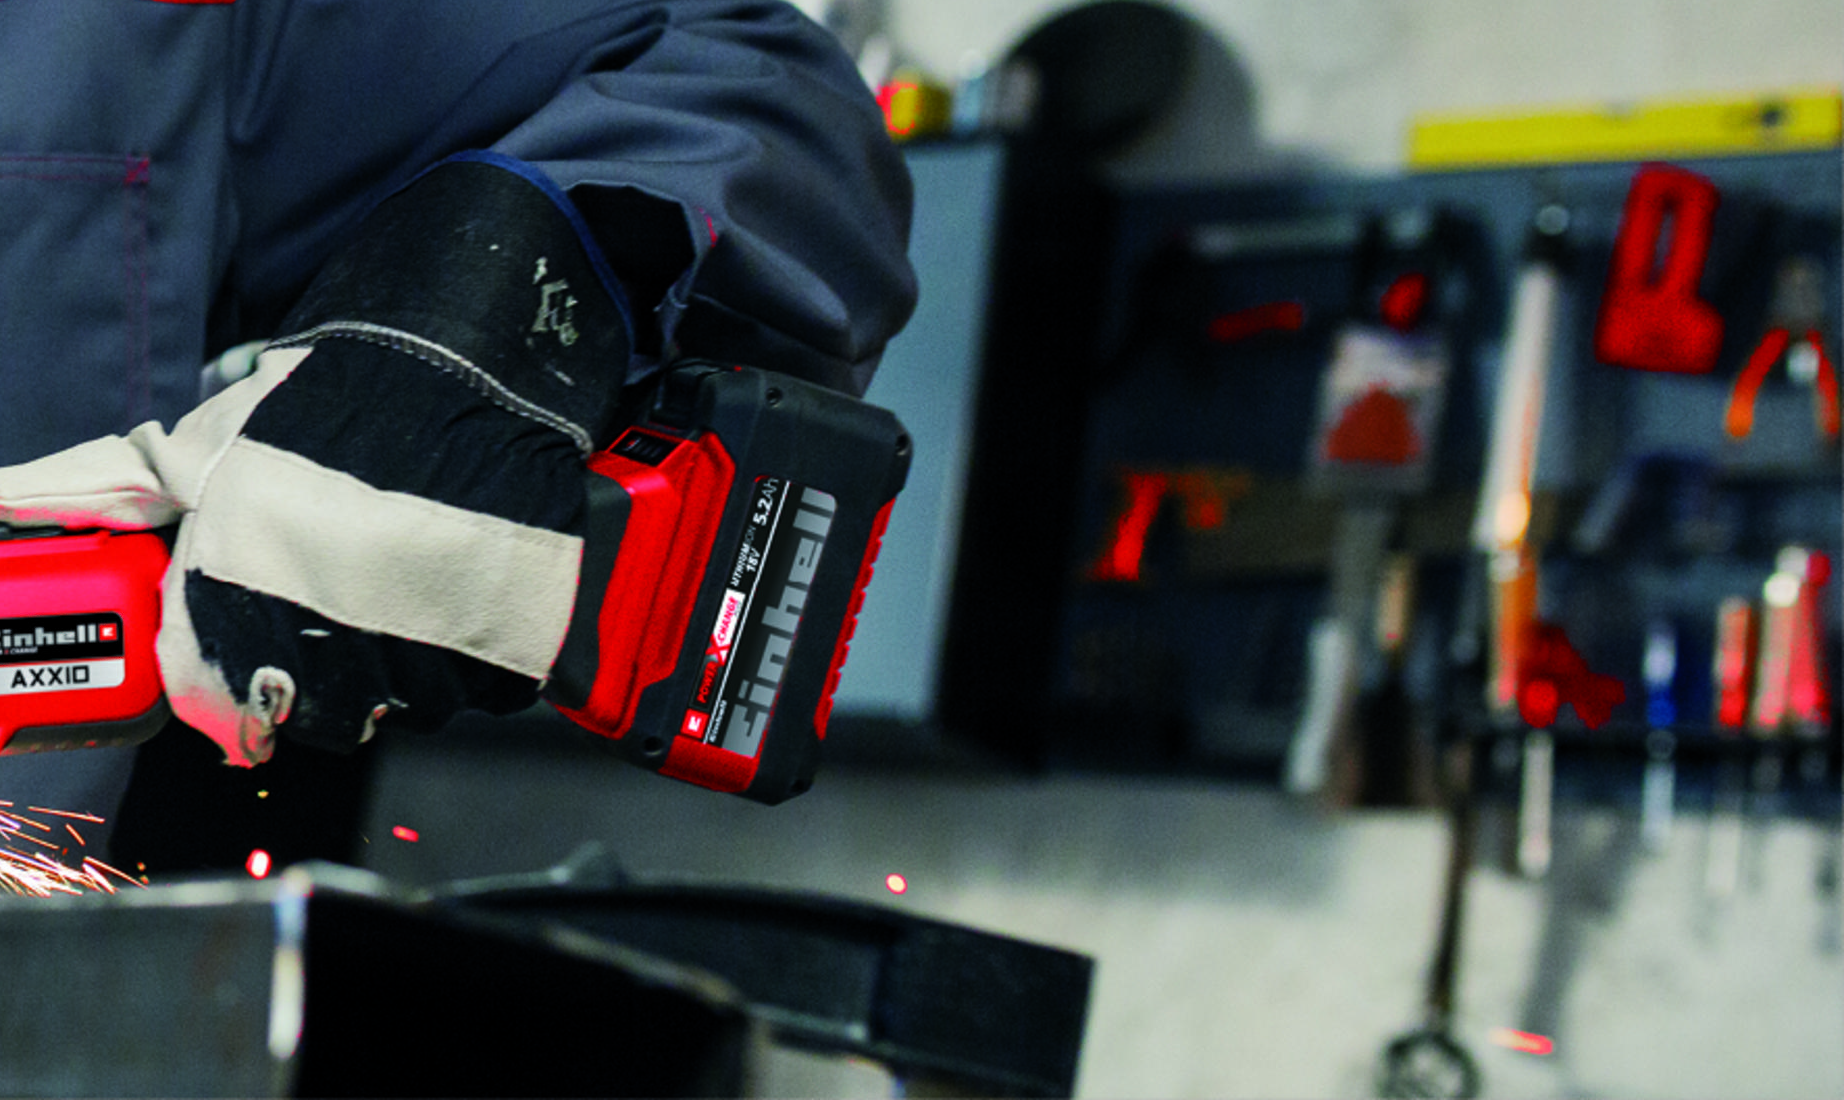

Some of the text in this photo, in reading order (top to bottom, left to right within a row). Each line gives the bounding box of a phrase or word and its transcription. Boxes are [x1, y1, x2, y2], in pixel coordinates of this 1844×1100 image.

[753, 477, 780, 526] 5.2Ah
[721, 486, 837, 758] Einhell
[11, 665, 90, 688] AXXIO
[696, 660, 719, 704] POWER
